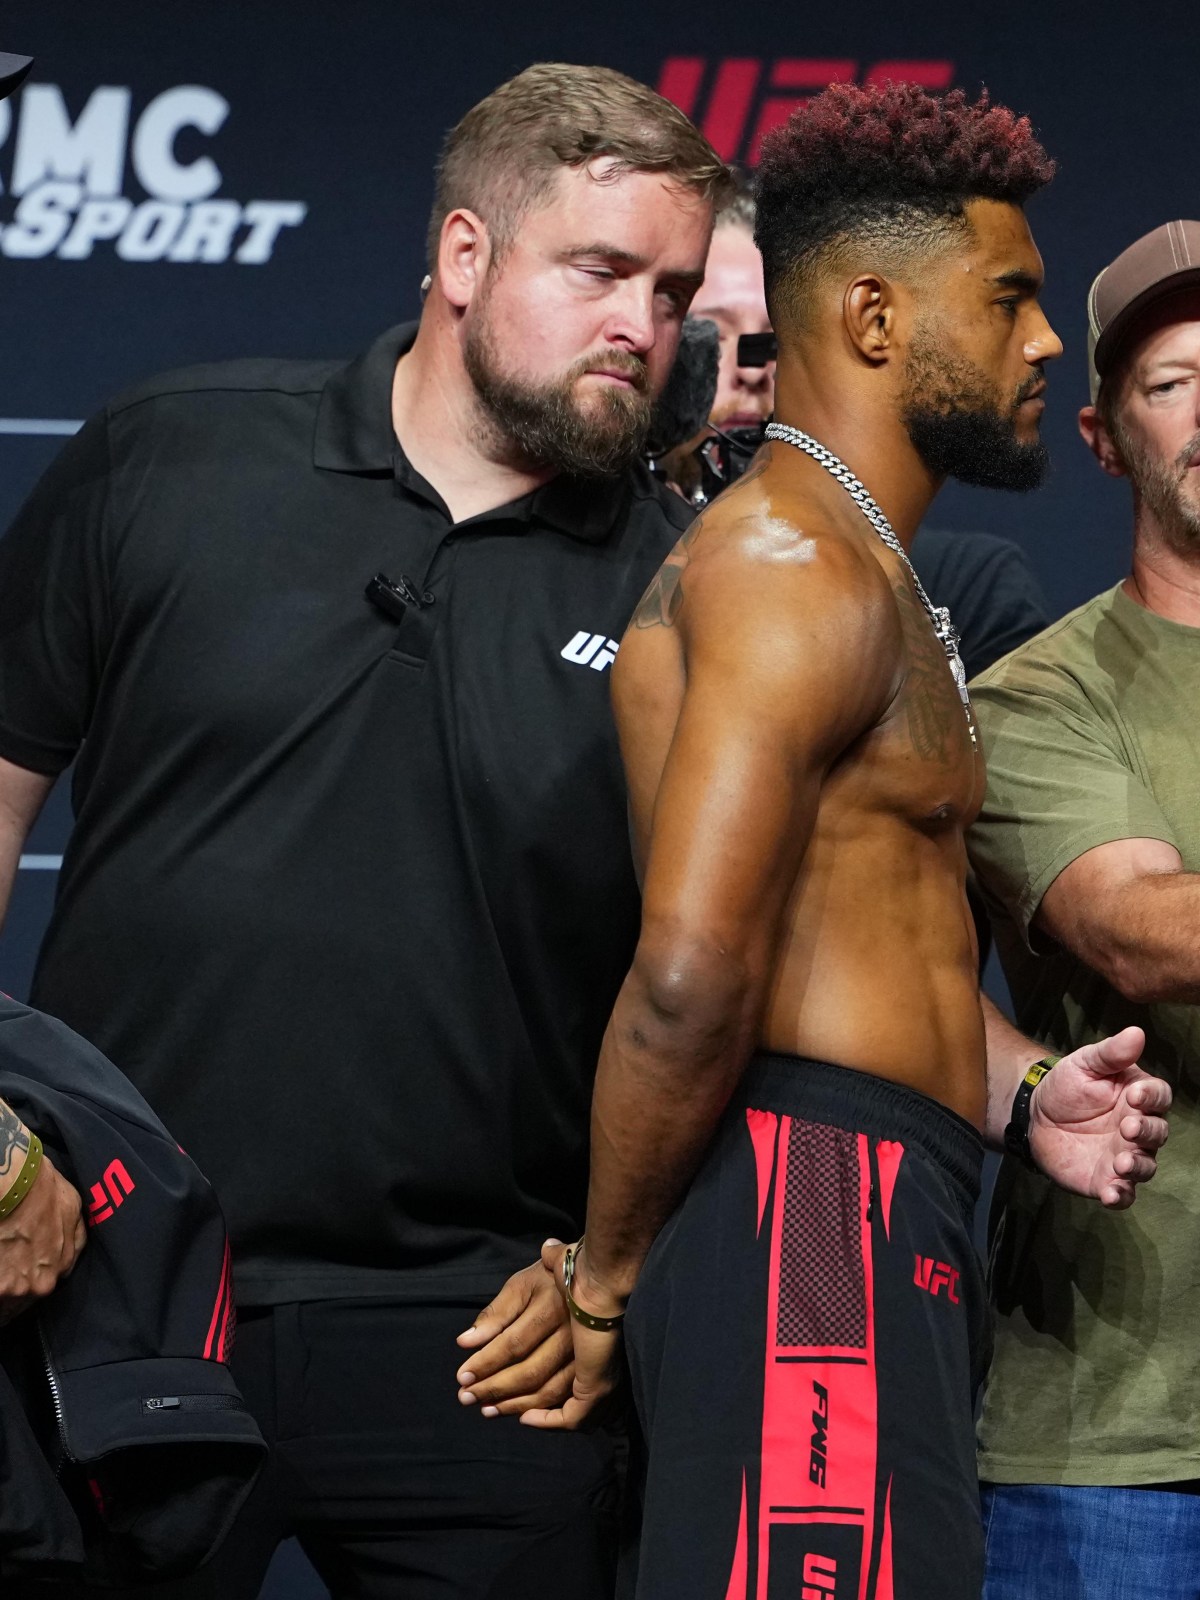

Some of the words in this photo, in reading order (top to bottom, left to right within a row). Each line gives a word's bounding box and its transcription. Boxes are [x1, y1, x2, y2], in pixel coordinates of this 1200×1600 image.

[0, 83, 231, 200] MC
[89, 1158, 136, 1228] UF
[913, 1254, 960, 1305] UFC
